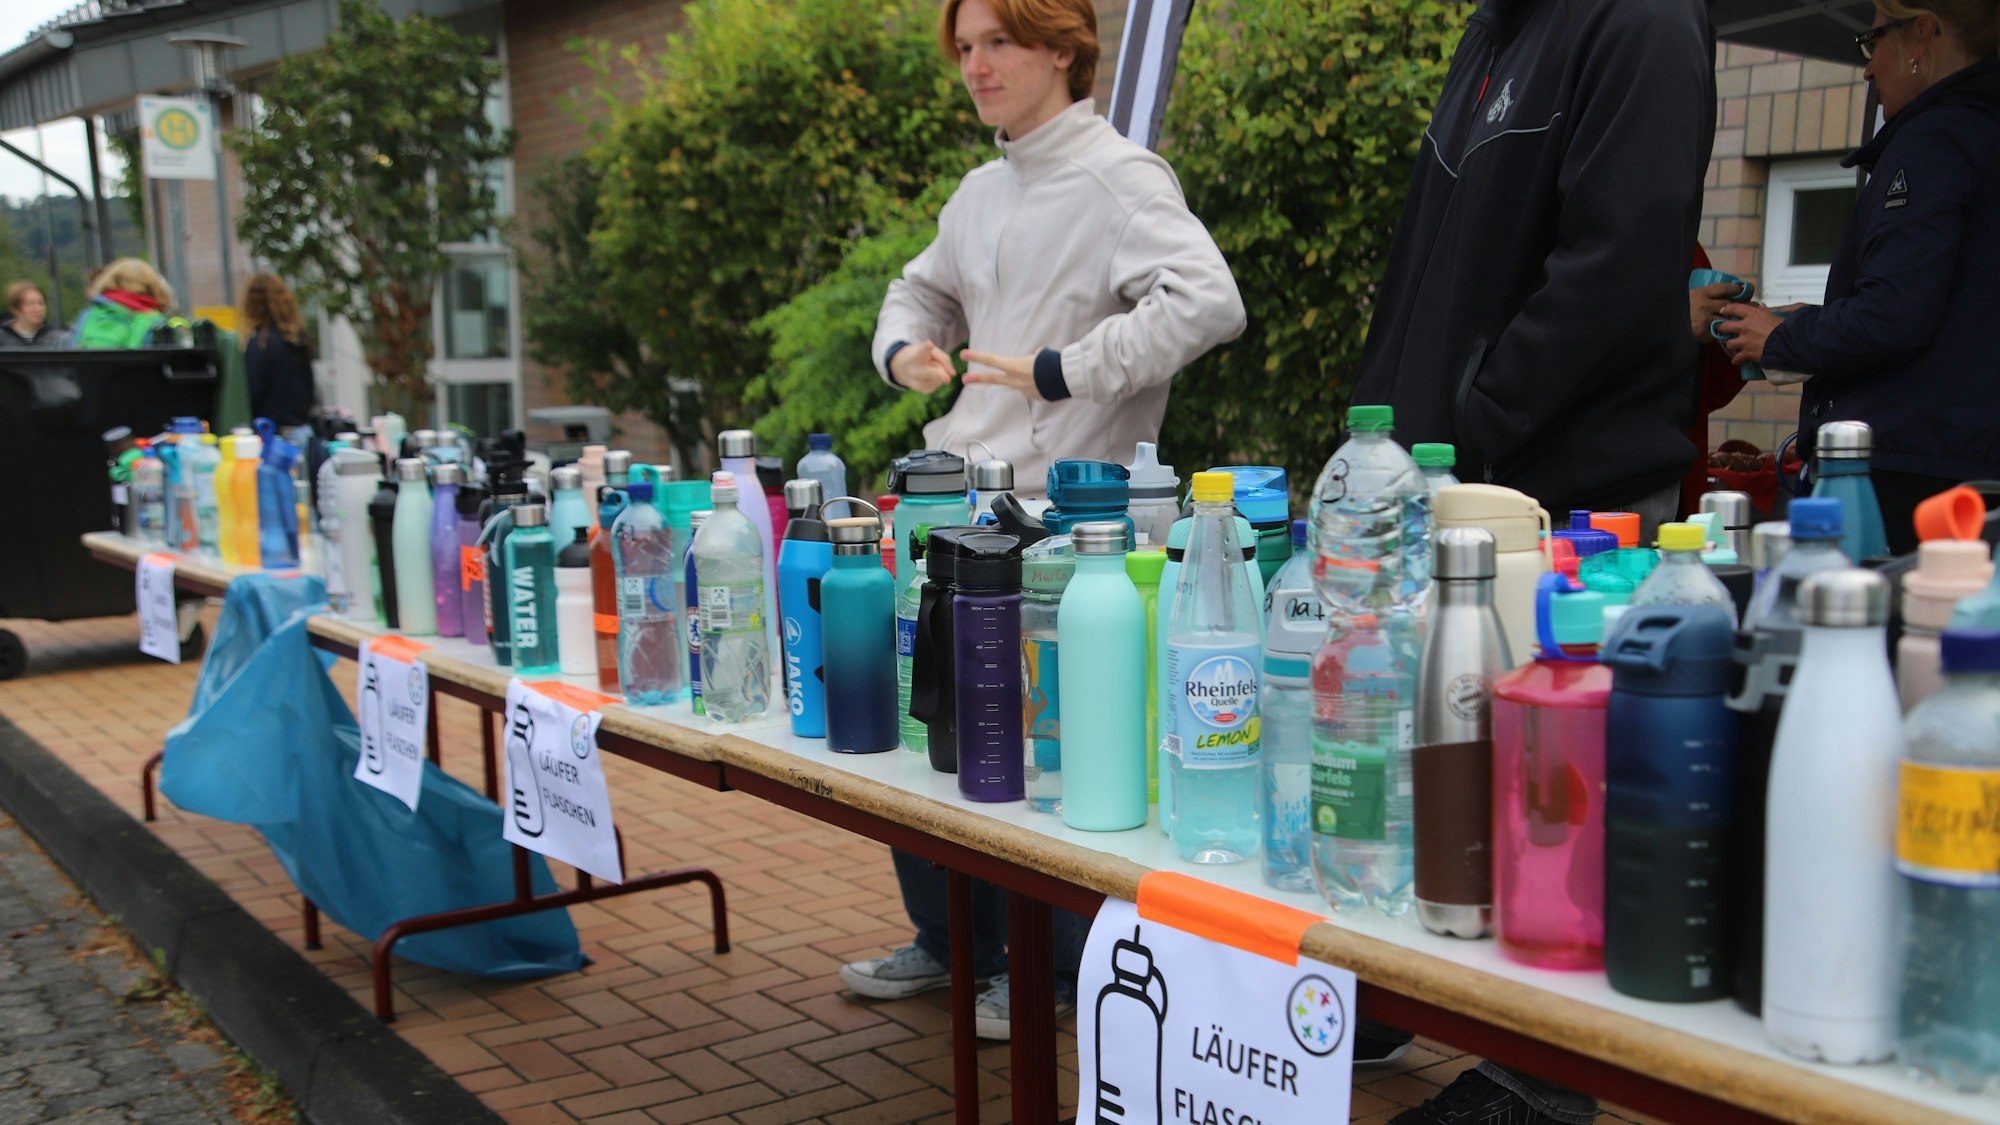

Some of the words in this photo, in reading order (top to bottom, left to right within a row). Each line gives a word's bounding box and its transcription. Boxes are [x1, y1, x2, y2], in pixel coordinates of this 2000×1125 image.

[512, 565, 539, 648] WATER
[787, 651, 804, 716] JAKO
[1185, 680, 1258, 697] Rheinfels
[1210, 698, 1239, 707] Quelle
[1196, 723, 1252, 749] LEMON
[538, 749, 580, 786] LÄUFER
[542, 787, 596, 828] FLASCHEN
[1192, 1024, 1299, 1097] LÄUFER
[1174, 1087, 1271, 1125] FLAS
